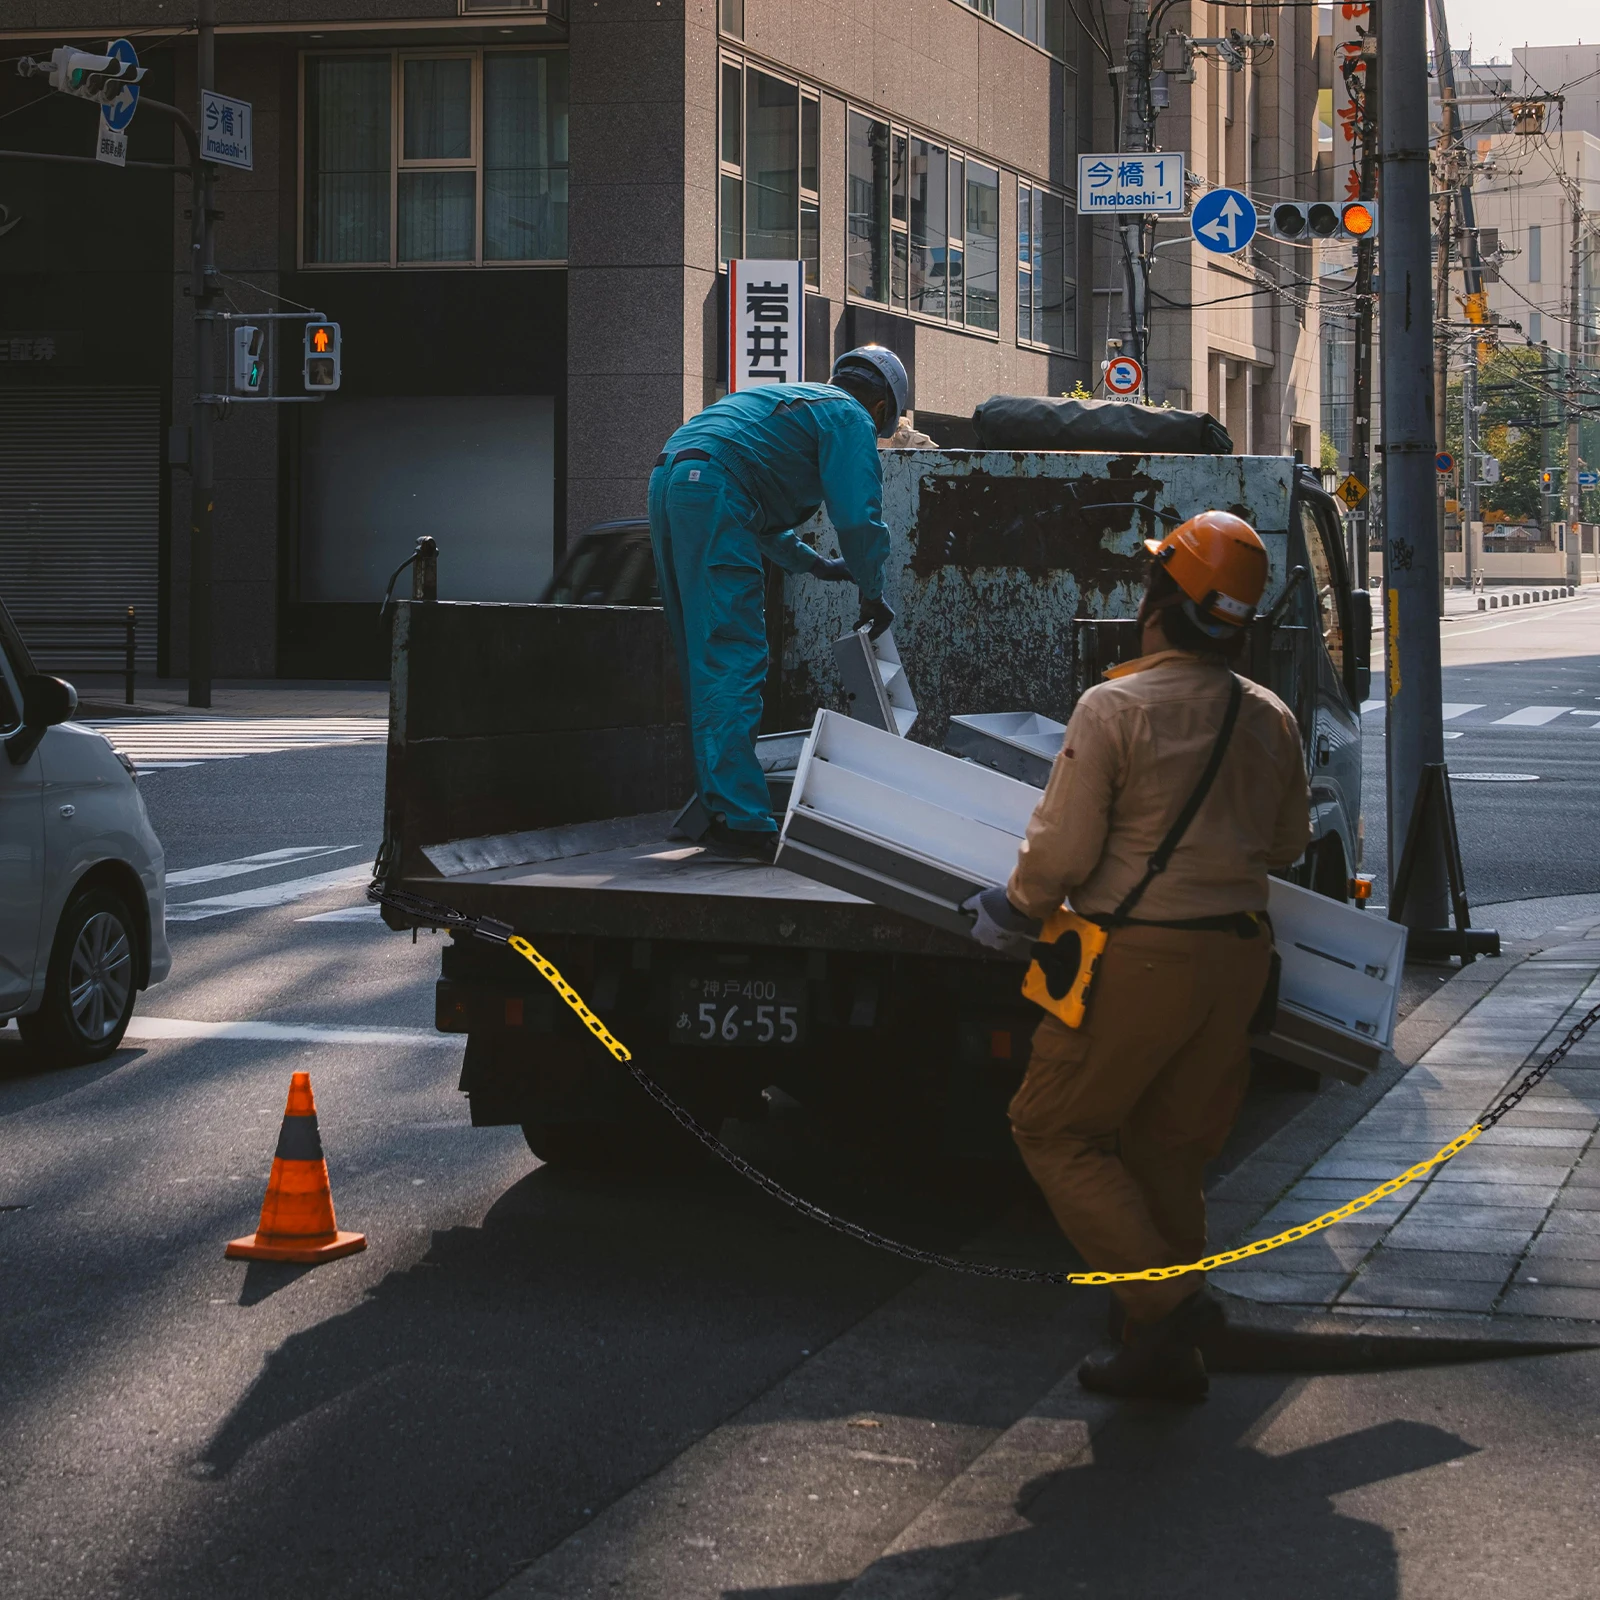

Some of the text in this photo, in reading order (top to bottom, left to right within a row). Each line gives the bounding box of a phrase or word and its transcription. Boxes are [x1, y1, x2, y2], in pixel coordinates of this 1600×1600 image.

[207, 135, 248, 160] Imabashi-1
[1090, 191, 1172, 206] Imabashi-1
[676, 1003, 798, 1043] あ 56-55
